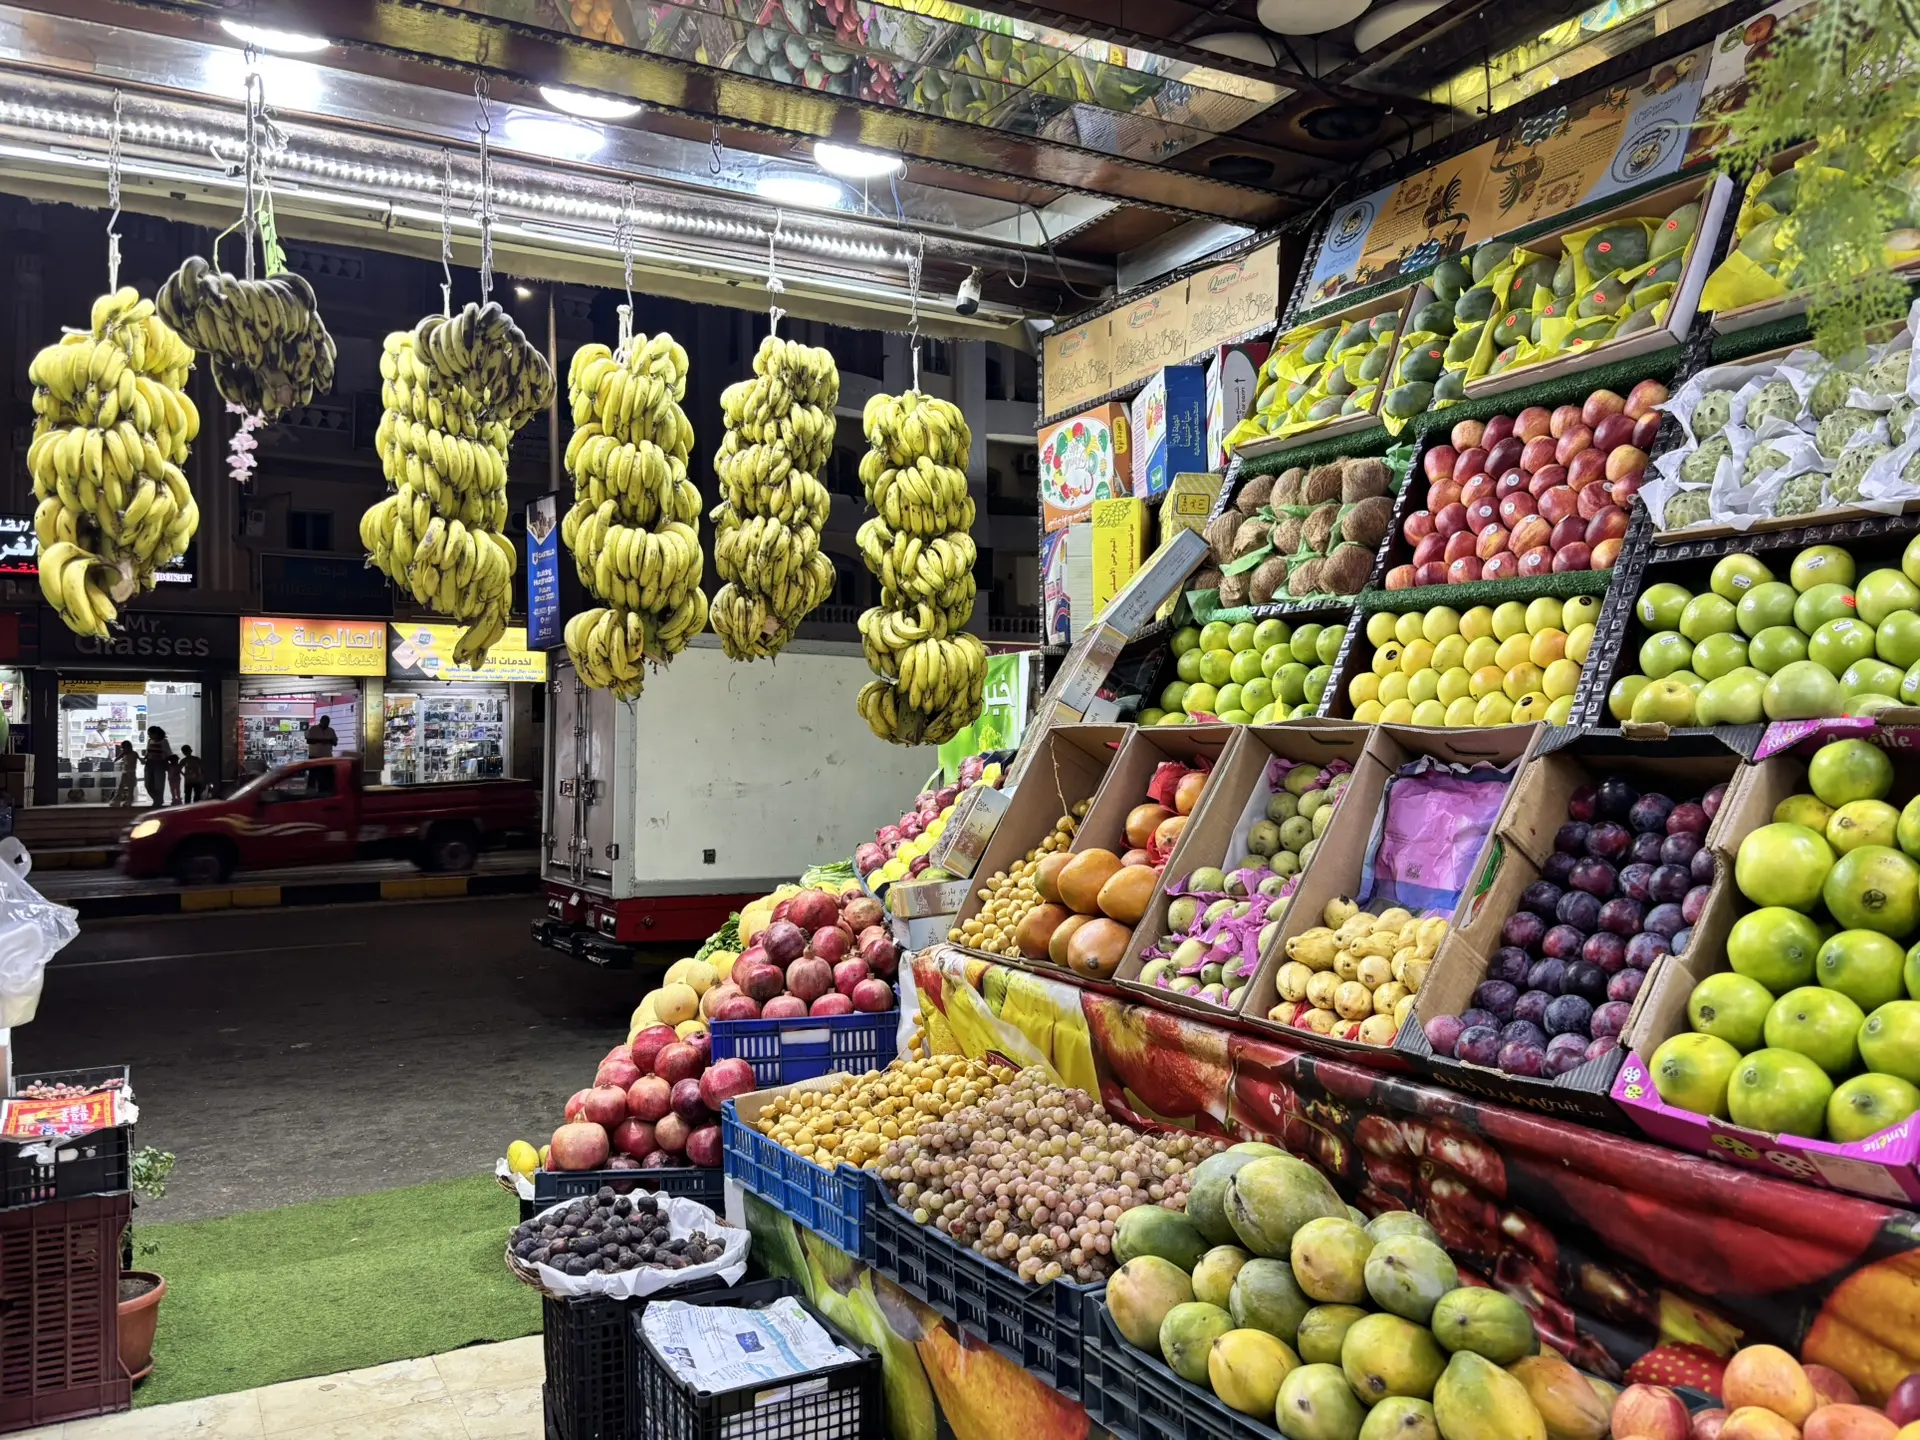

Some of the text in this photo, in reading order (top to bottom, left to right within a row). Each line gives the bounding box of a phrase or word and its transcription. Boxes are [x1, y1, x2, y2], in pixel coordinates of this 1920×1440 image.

[1208, 272, 1237, 291] Queen
[1129, 308, 1155, 328] Queen
[125, 614, 167, 634] Mr.
[292, 625, 383, 652] العالمية
[295, 652, 379, 668] لخدمات المحمول
[499, 657, 532, 666] لخدمات
